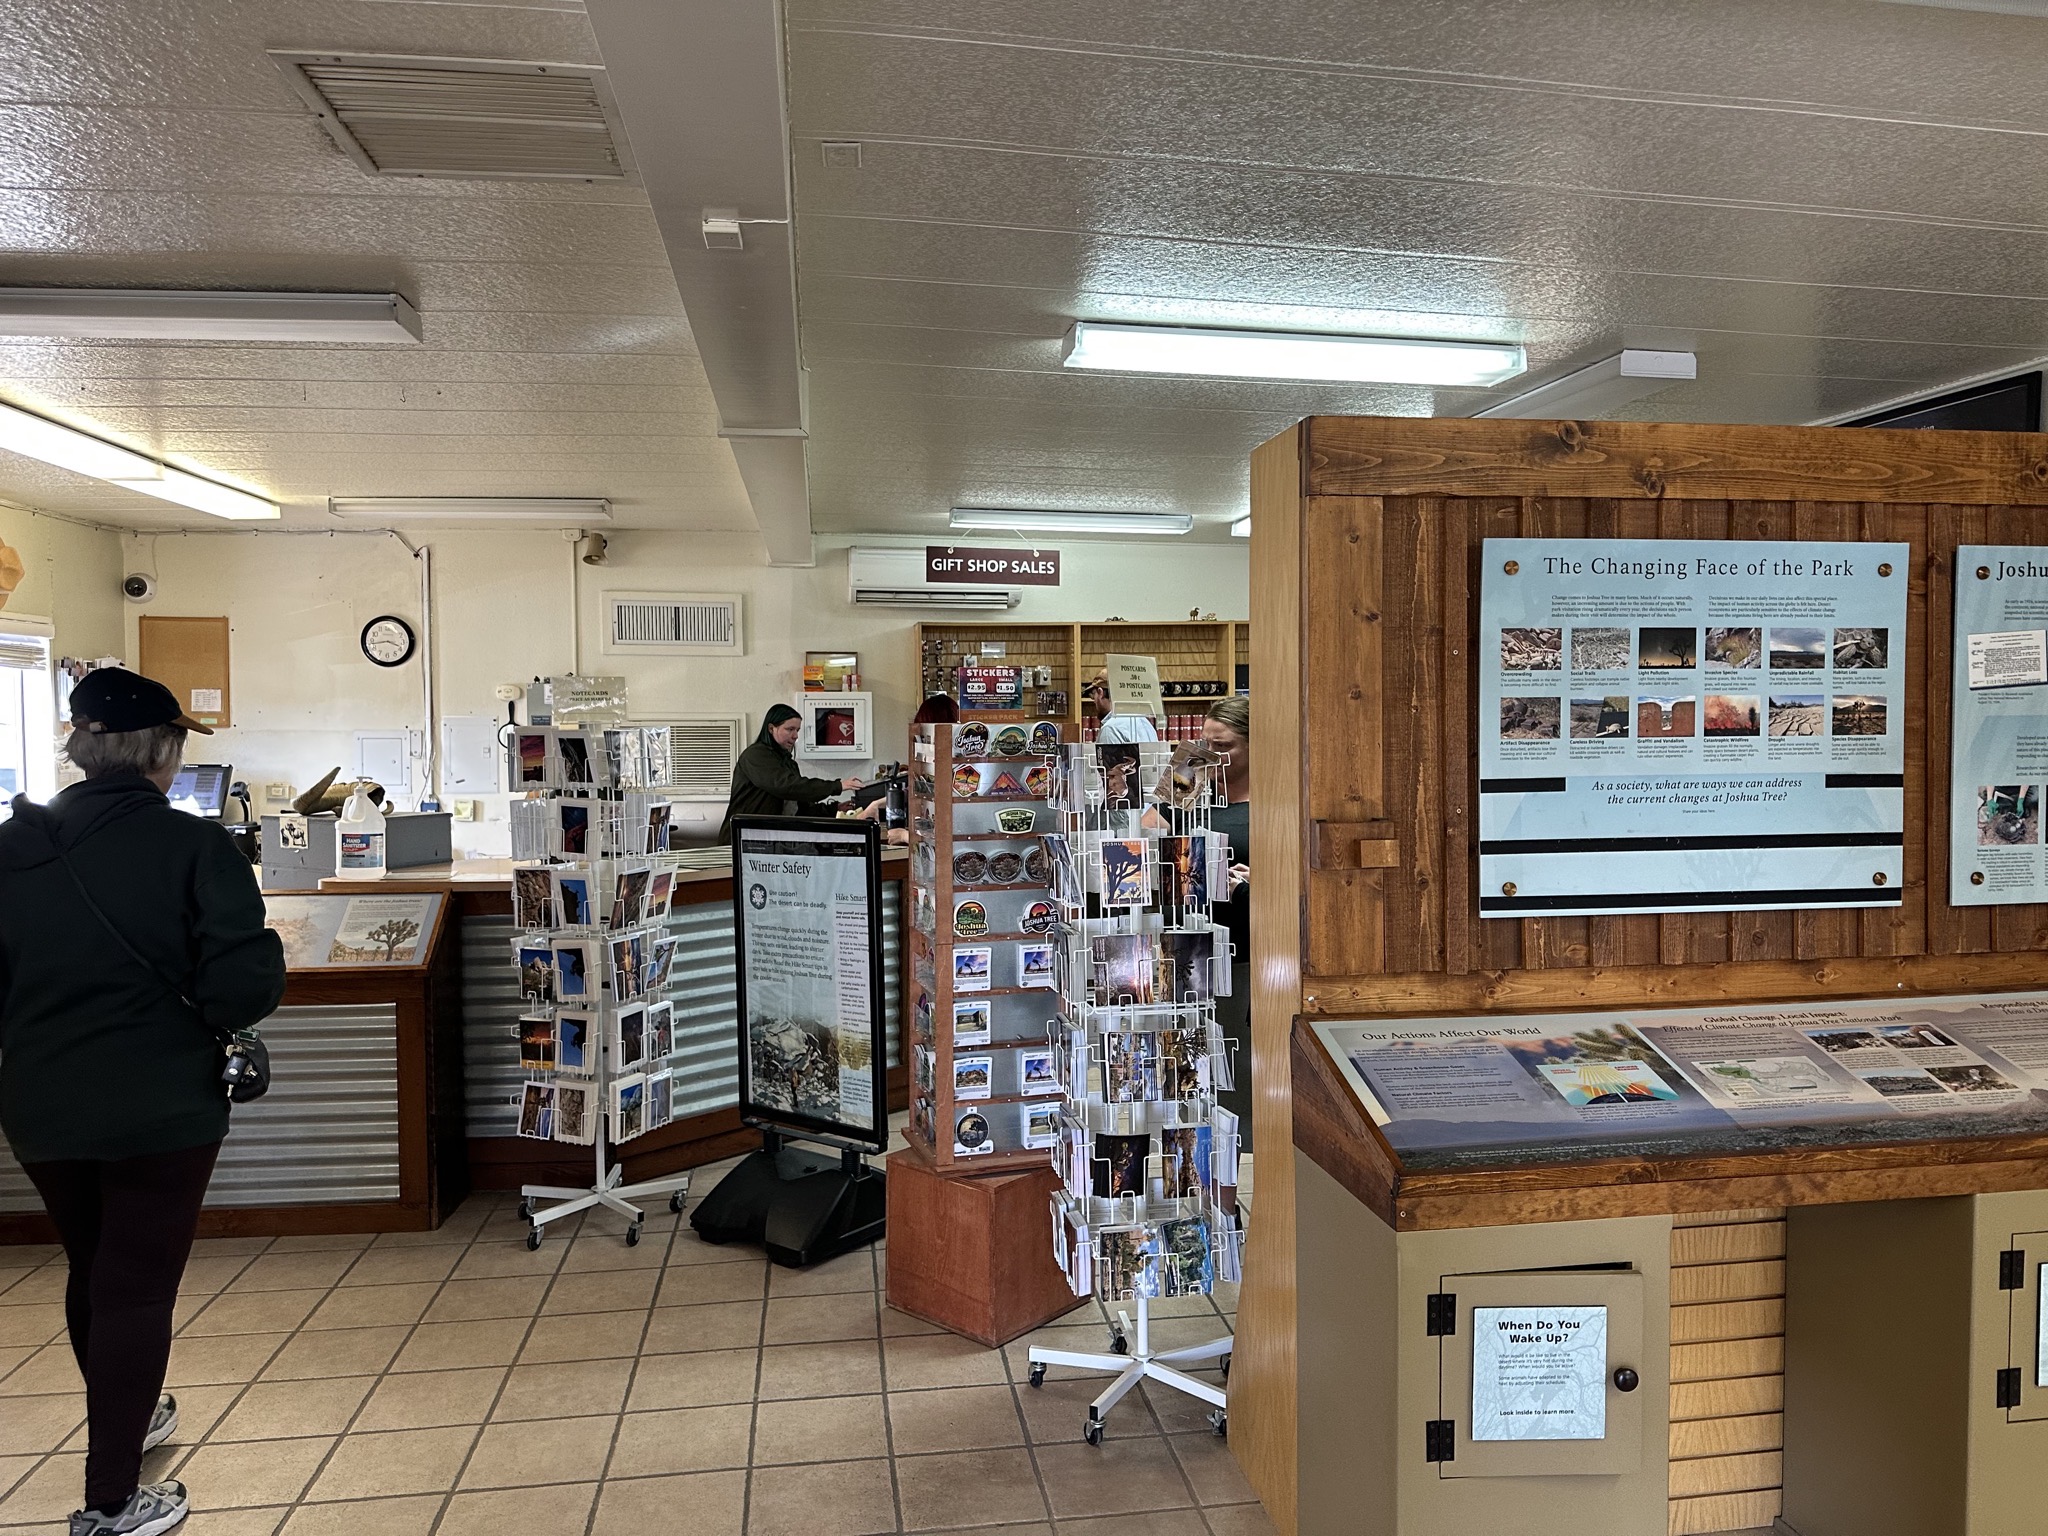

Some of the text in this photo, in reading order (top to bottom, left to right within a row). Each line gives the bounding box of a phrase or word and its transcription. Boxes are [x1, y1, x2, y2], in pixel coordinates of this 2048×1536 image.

[932, 558, 1055, 574] GIFT SHOP SALES
[1544, 558, 1854, 580] The Changing Face of the Park
[957, 735, 981, 745] Joshua
[1592, 781, 1604, 790] As
[1615, 782, 1653, 792] society,
[1655, 780, 1680, 789] what
[1701, 782, 1726, 791] ways
[1764, 779, 1802, 788] address
[1608, 795, 1624, 804] the
[1626, 795, 1666, 803] current
[1668, 793, 1709, 805] changes
[1724, 792, 1758, 804] Joshua
[1761, 792, 1787, 801] Tree?
[749, 860, 811, 878] Winter Safety
[850, 894, 866, 902] Smart
[1024, 917, 1044, 927] JOSHUA
[1391, 1031, 1435, 1040] Actions
[1440, 1030, 1474, 1039] Affect
[1503, 1027, 1541, 1036] World
[1498, 1320, 1580, 1330] When Do You
[1510, 1334, 1569, 1344] Wake Up?
[139, 1501, 151, 1513] FILA
